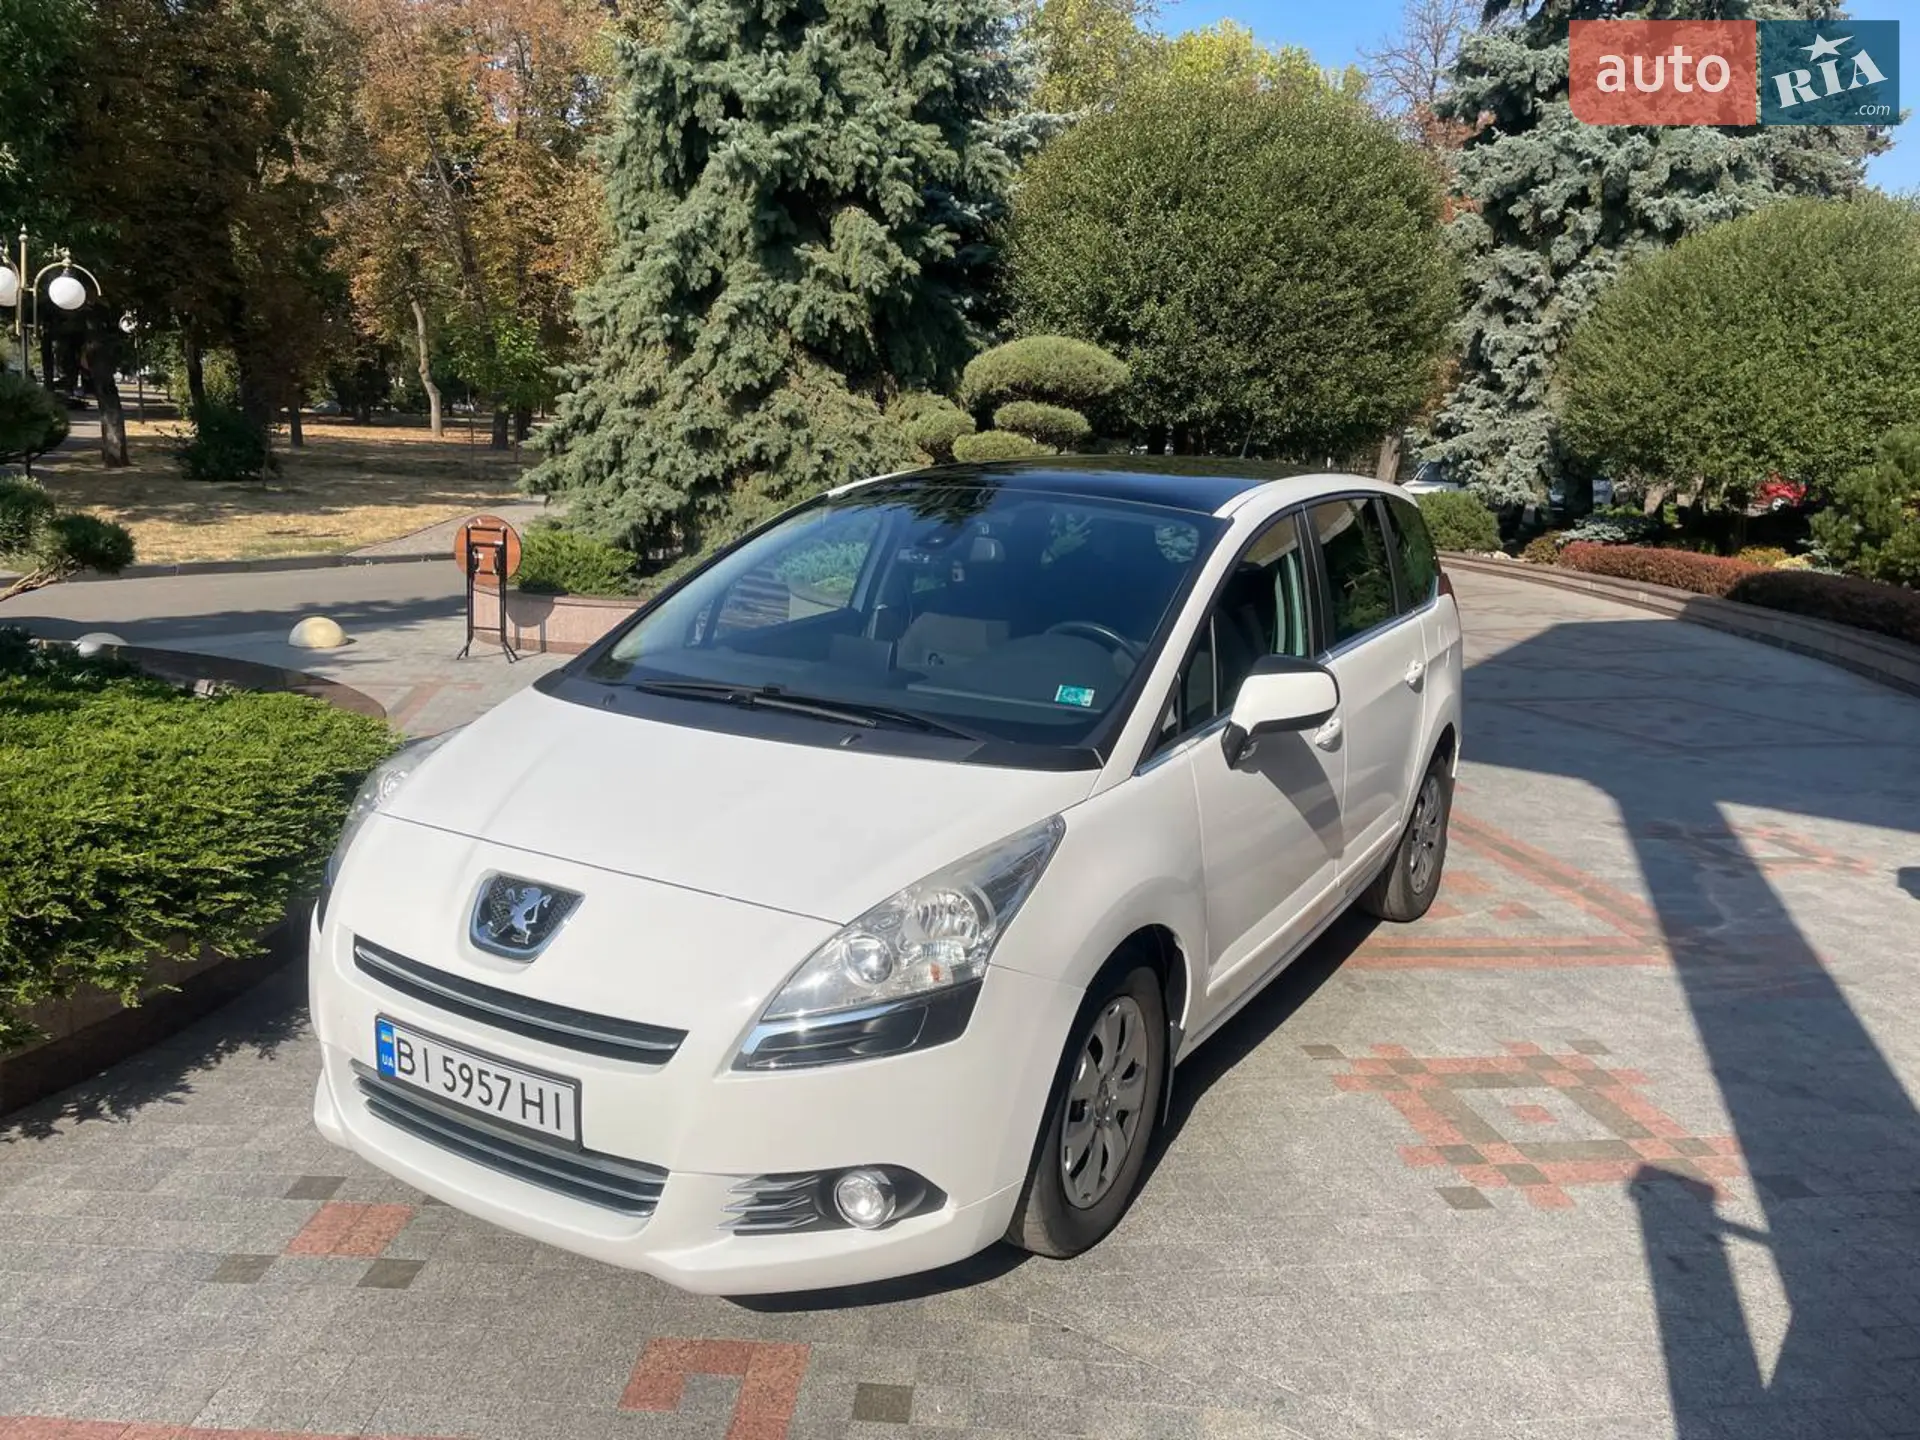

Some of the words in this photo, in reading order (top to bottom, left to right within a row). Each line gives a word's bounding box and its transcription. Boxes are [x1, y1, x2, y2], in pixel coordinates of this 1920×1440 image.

[381, 1053, 394, 1069] UA
[396, 1036, 430, 1084] BI
[442, 1055, 512, 1112] 5957
[520, 1082, 561, 1131] HI
